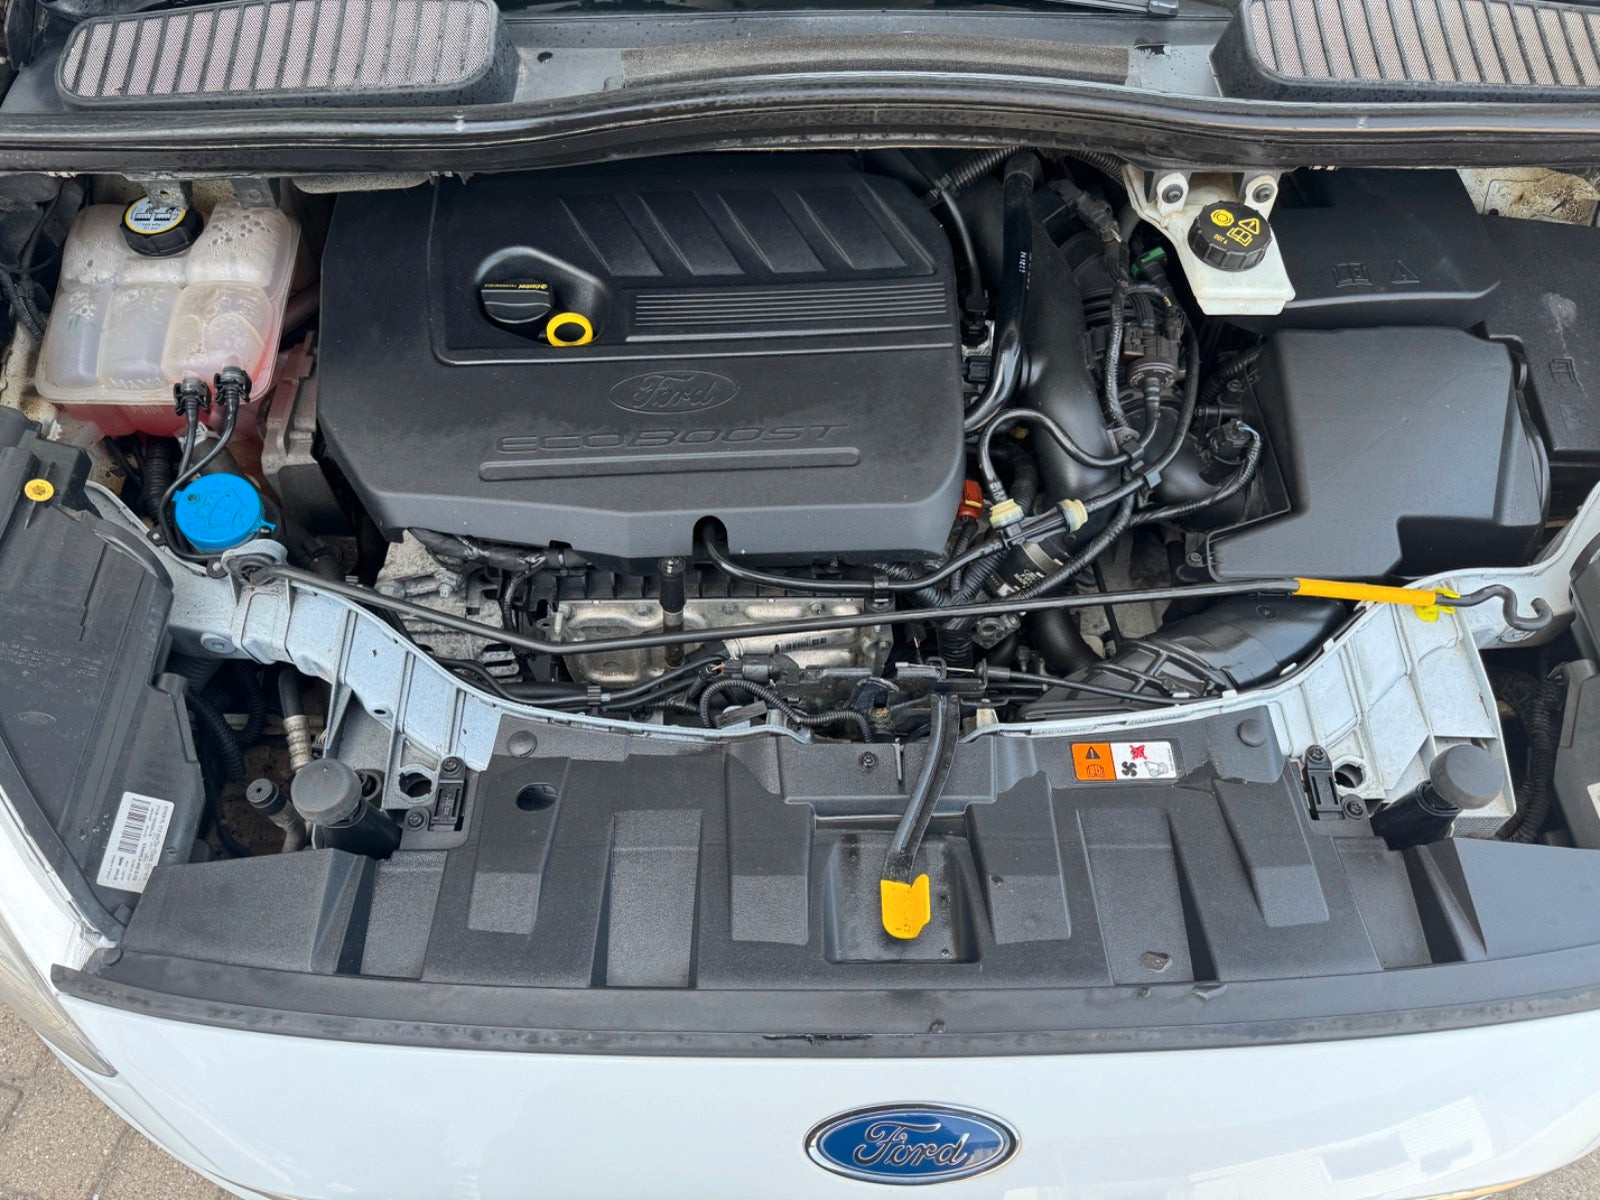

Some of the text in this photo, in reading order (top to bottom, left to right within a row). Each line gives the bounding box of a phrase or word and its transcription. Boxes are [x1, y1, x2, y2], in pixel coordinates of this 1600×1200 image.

[633, 374, 718, 409] Ford
[498, 423, 849, 454] ECOBOOST
[852, 1120, 970, 1166] Ford
